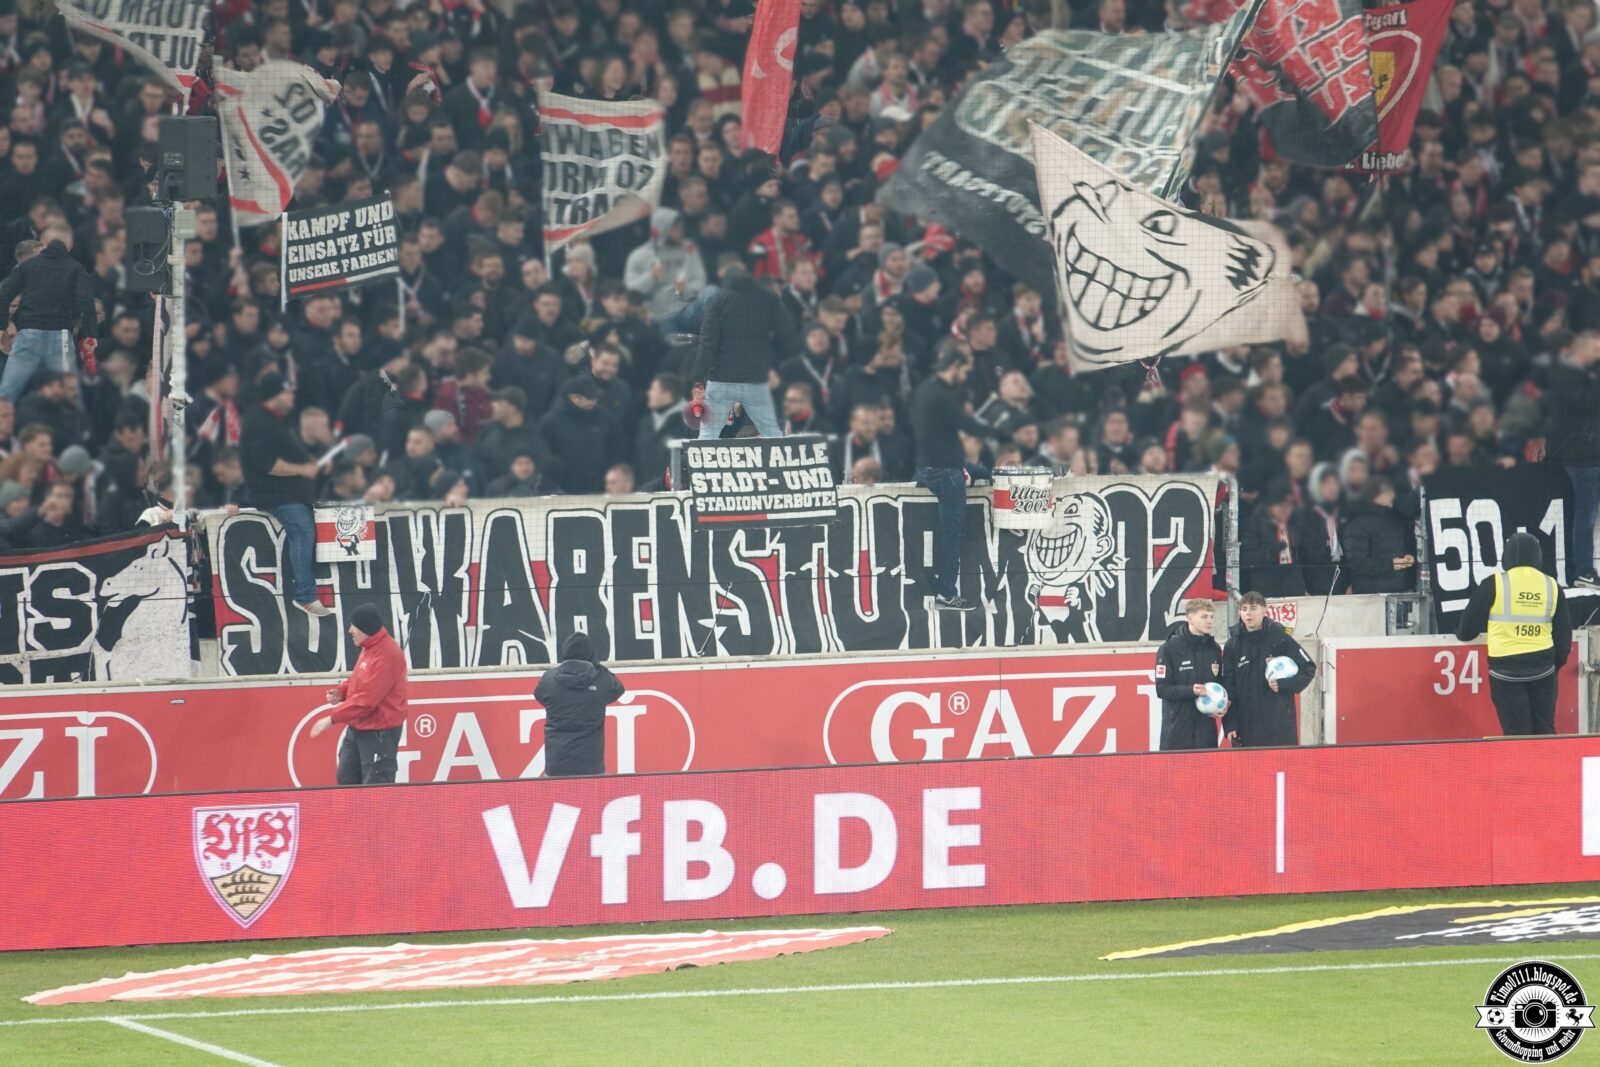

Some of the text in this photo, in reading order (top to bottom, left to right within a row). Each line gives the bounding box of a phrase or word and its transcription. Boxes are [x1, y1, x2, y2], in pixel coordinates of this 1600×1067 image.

[287, 200, 394, 241] KAMPF UND
[287, 223, 397, 264] EINSATZ FÜR
[288, 247, 398, 283] UNSERE FARBEN!
[687, 442, 829, 469] GEGEN ALLE
[691, 467, 834, 493] STADT- UND
[695, 490, 837, 512] STADIONVERBOTE!
[1518, 591, 1541, 601] SDS
[1514, 624, 1541, 637] 1589
[1433, 650, 1483, 695] 34
